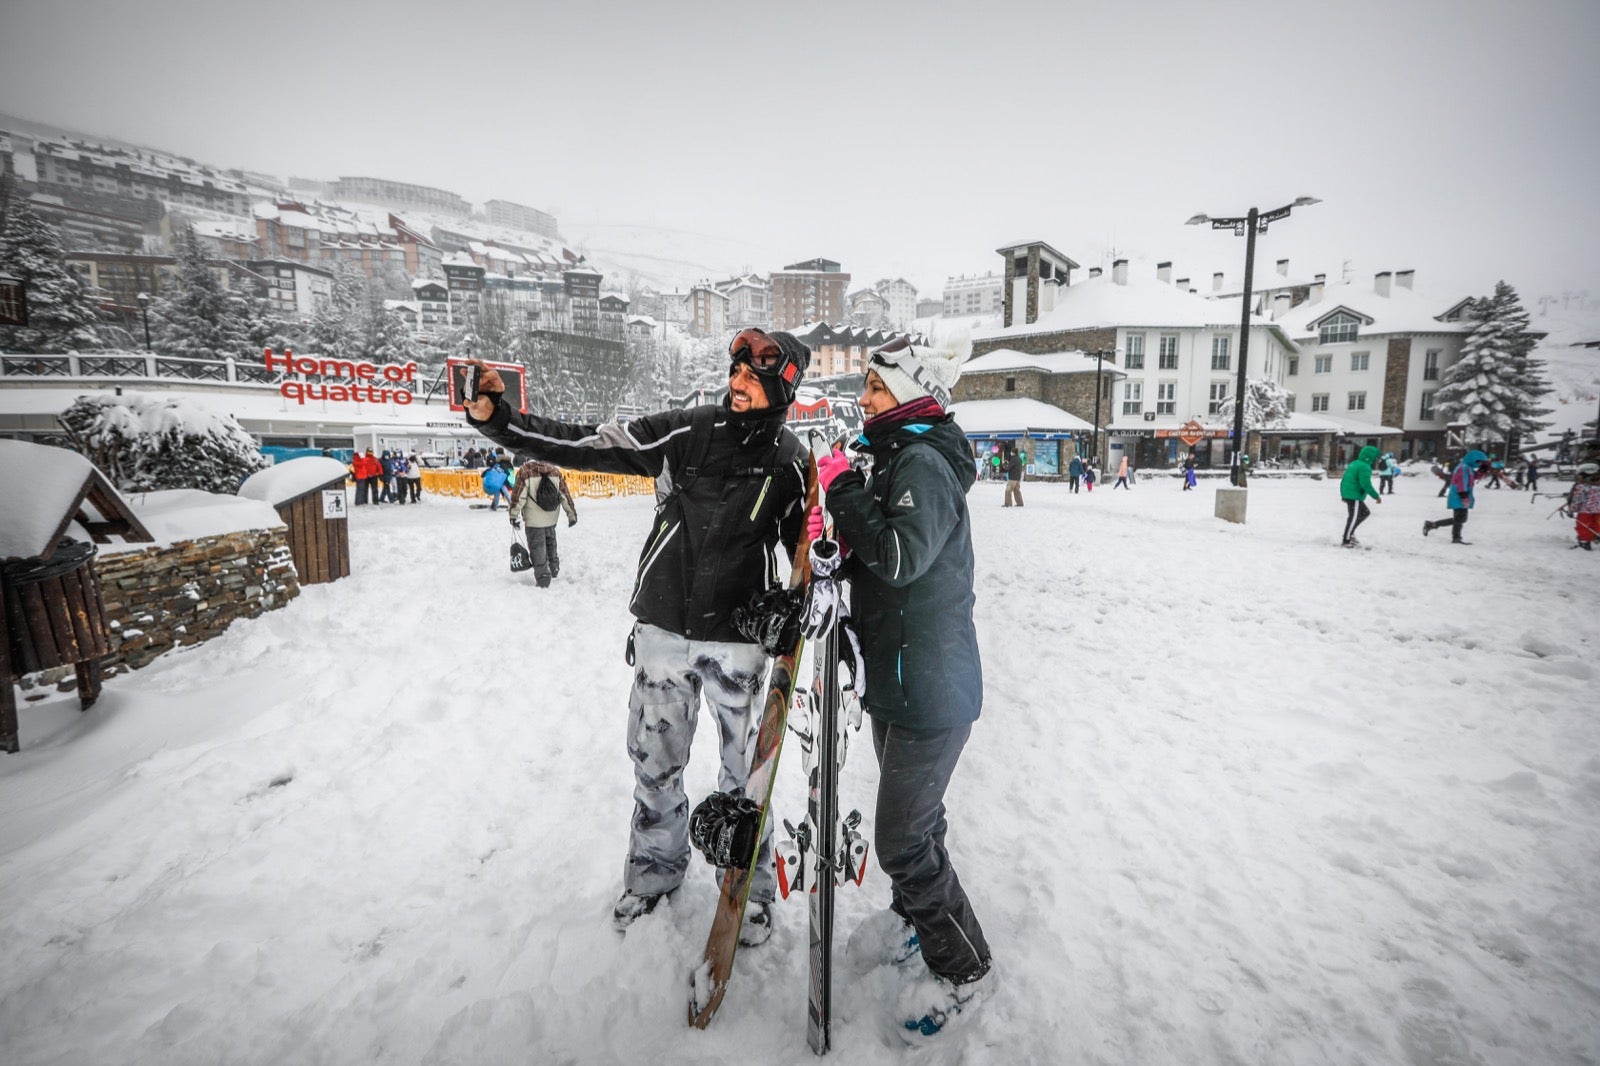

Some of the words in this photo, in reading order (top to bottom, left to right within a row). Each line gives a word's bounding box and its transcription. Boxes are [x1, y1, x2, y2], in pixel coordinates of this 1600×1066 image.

[264, 348, 376, 380] Home
[383, 362, 417, 382] of
[280, 382, 413, 405] quattro
